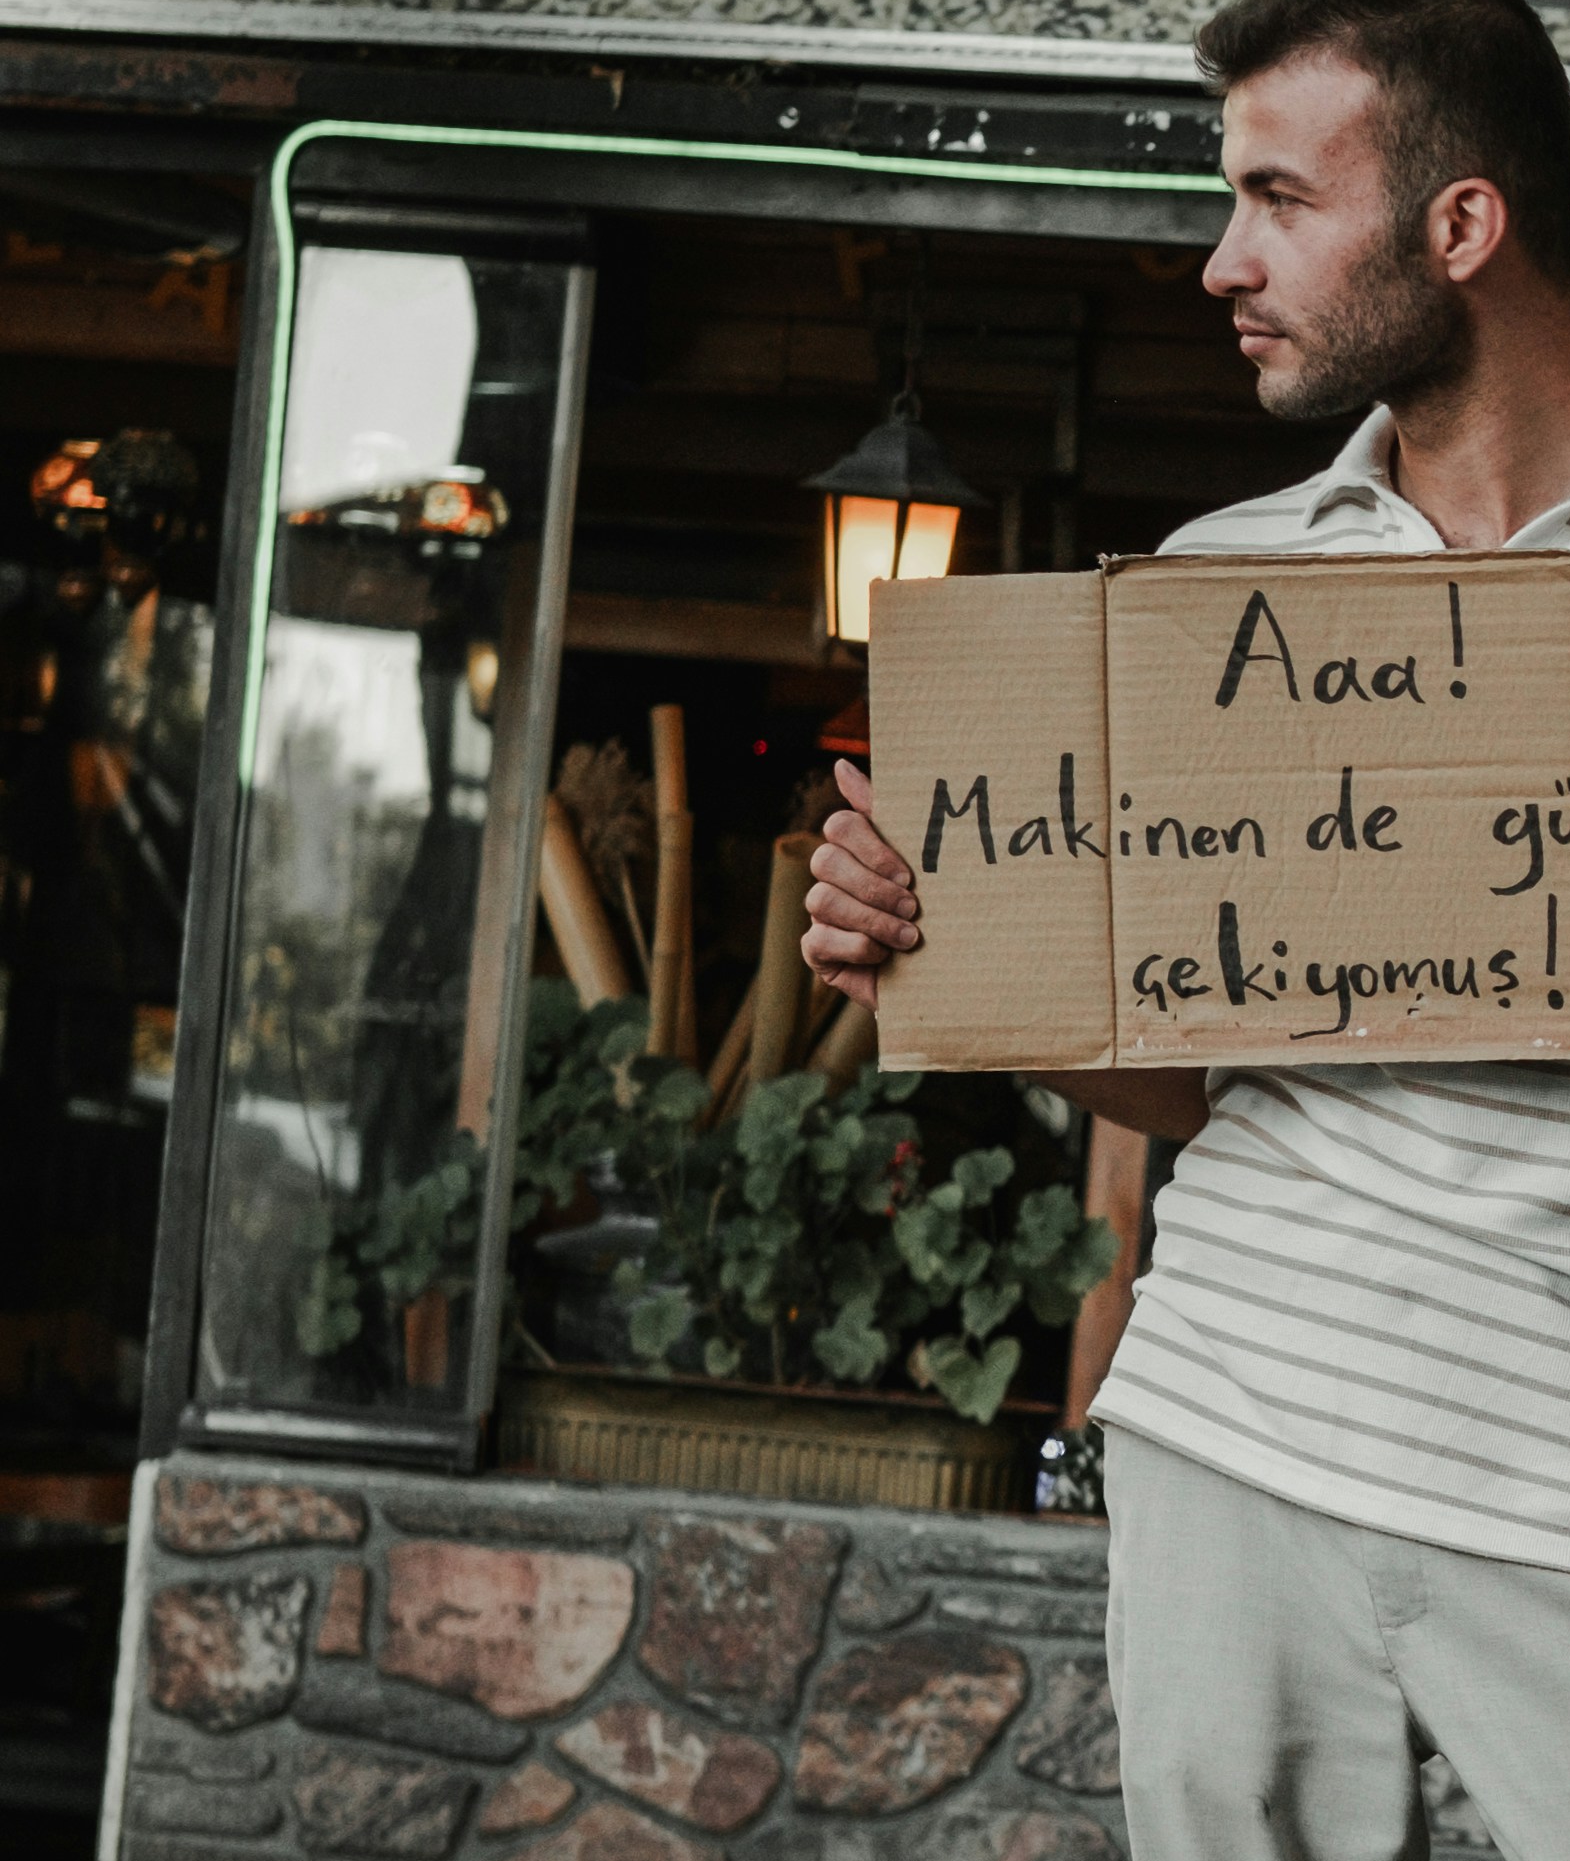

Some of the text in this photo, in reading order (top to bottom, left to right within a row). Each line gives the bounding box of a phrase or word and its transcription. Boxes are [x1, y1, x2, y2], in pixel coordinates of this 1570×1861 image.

[1215, 580, 1469, 709] Aaa!
[920, 751, 1267, 875] Makinen
[1305, 764, 1403, 854] de
